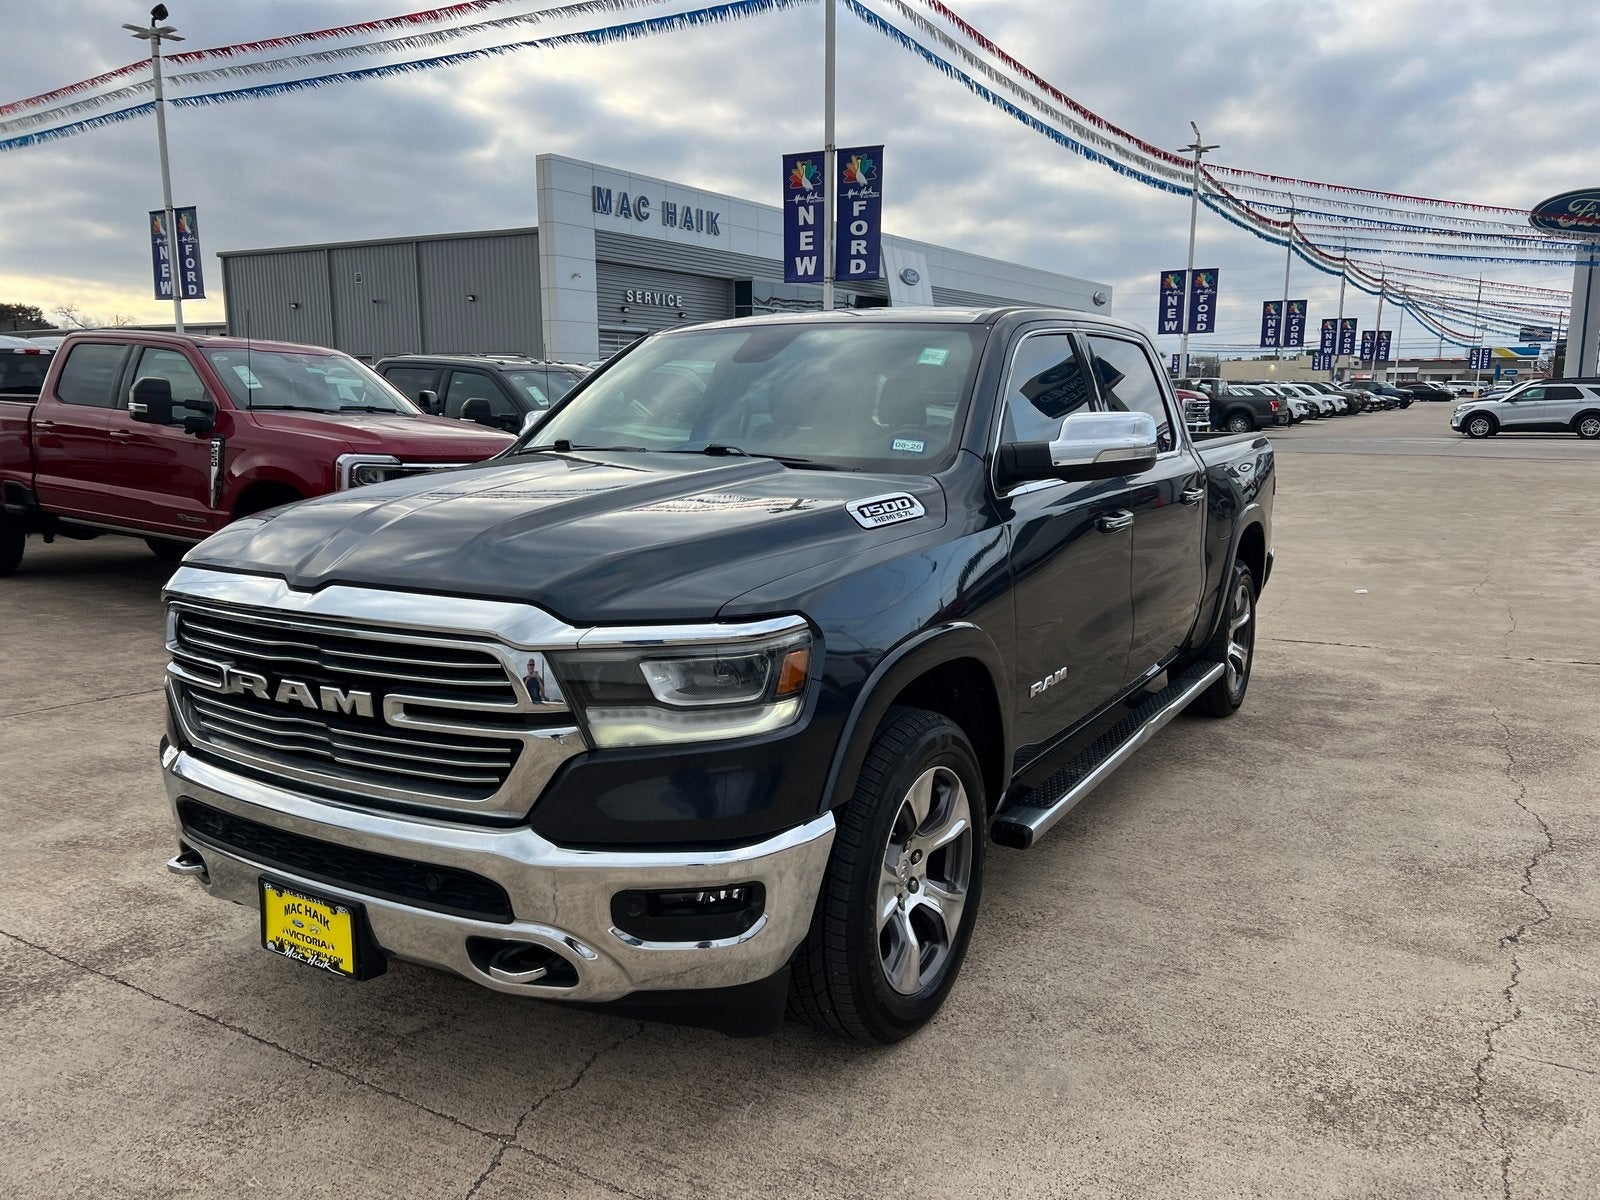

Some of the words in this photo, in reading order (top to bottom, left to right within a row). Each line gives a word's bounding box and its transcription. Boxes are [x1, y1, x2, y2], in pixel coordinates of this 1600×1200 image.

[592, 185, 650, 222] MAC
[661, 201, 721, 236] HAIK
[795, 204, 818, 276] NEW
[849, 200, 869, 275] FORD
[159, 245, 172, 295] NEW
[184, 244, 198, 295] FORD
[626, 289, 683, 307] SERVICE
[1164, 295, 1178, 331] NEW
[1196, 294, 1209, 331] FORD
[1265, 319, 1276, 346] NEW
[1289, 318, 1300, 346] FORD
[1323, 333, 1333, 354] NEW
[860, 498, 911, 517] 1500
[873, 512, 896, 524] HEMI
[895, 510, 914, 519] 5.7L
[229, 668, 375, 718] RAM
[1030, 666, 1068, 699] RAM
[284, 902, 303, 916] MAC
[304, 905, 331, 931] HAIK
[288, 928, 328, 950] VICTORIA
[283, 946, 304, 959] Mac
[306, 954, 331, 969] Haik
